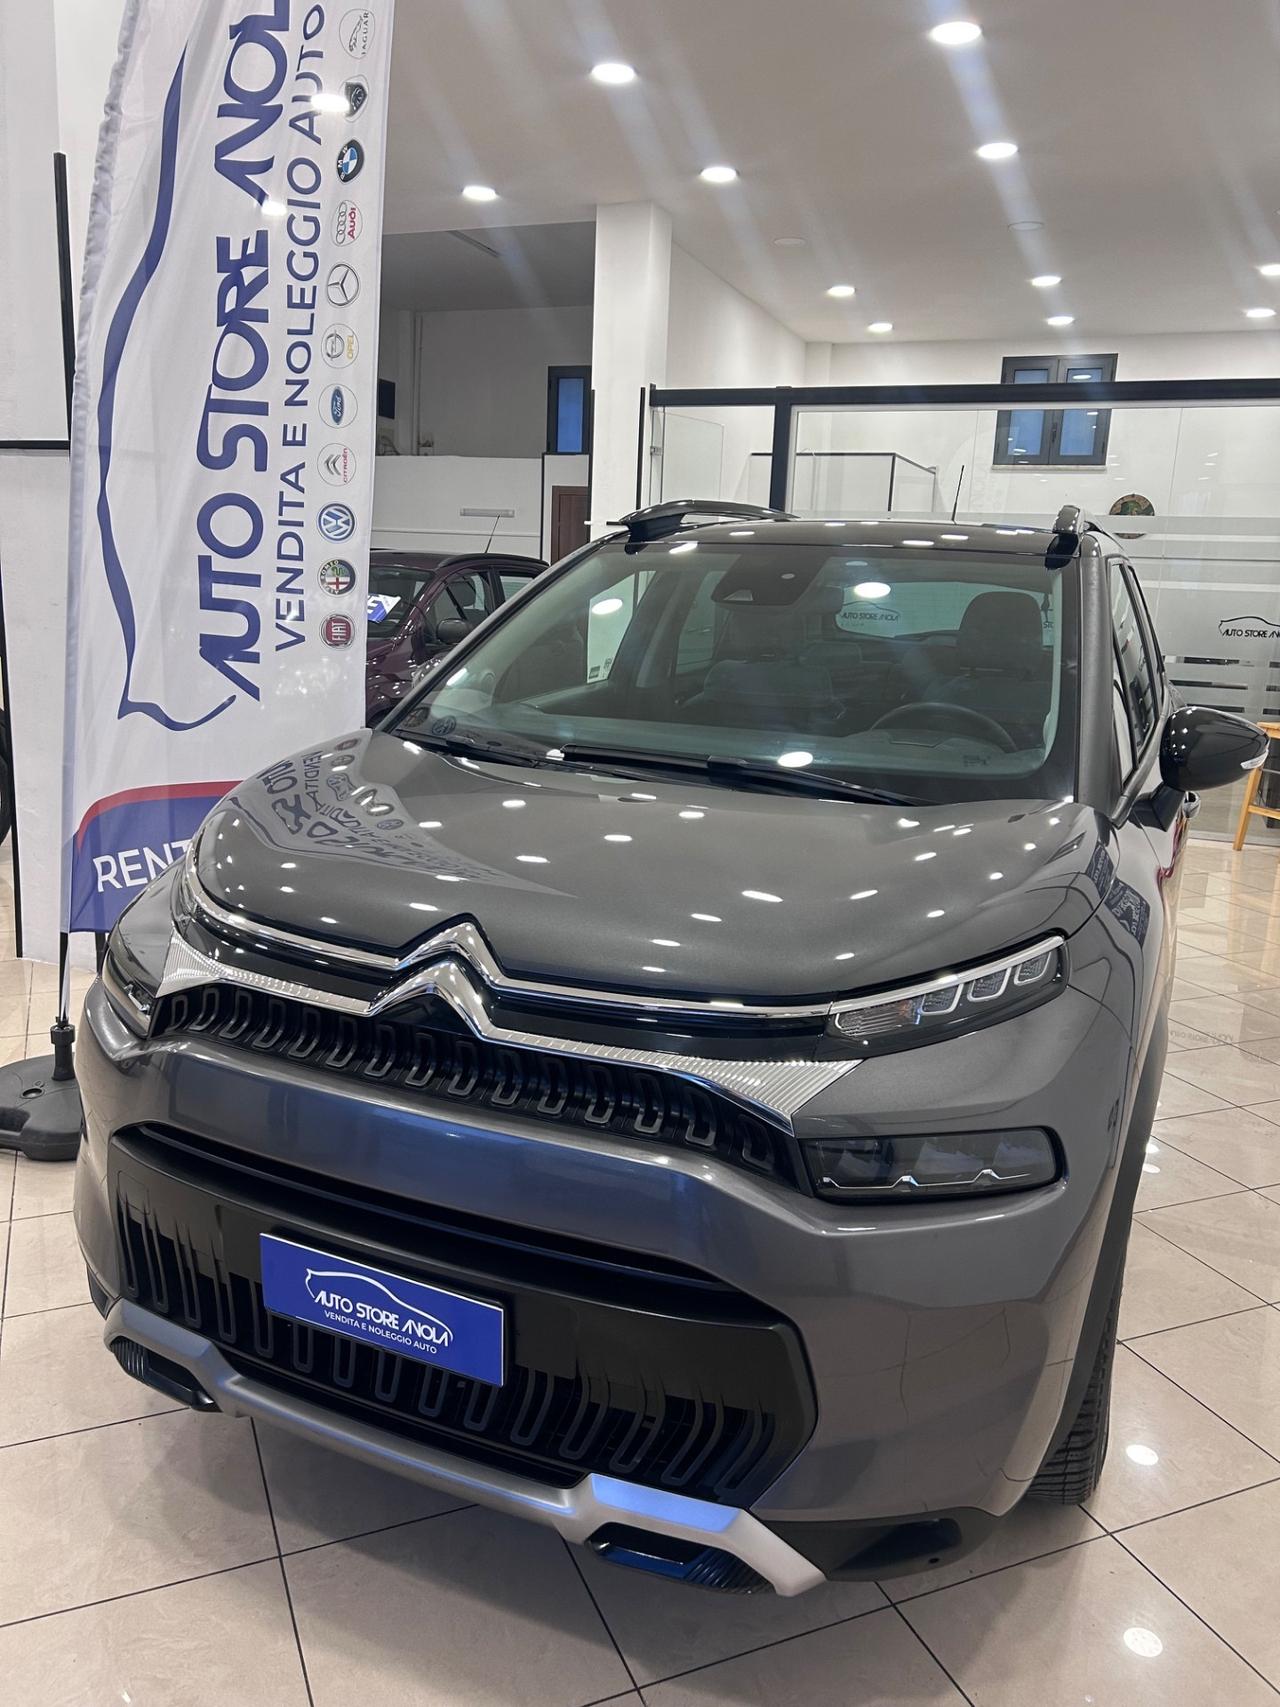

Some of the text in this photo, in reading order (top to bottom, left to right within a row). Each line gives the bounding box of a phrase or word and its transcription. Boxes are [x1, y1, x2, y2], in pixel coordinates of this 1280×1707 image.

[361, 12, 369, 55] JAGUAR
[275, 4, 324, 651] VENDITA E NOLEGGIO AUTO
[197, 230, 269, 471] STORE
[197, 493, 264, 701] AUTO
[331, 621, 347, 641] FIAT
[1223, 629, 1243, 637] AUTO
[1244, 629, 1267, 638] STORE
[314, 1290, 353, 1313] AUTO
[356, 1302, 399, 1330] STORE
[324, 1310, 437, 1354] VENDITA E NOLEGGIO AUTO
